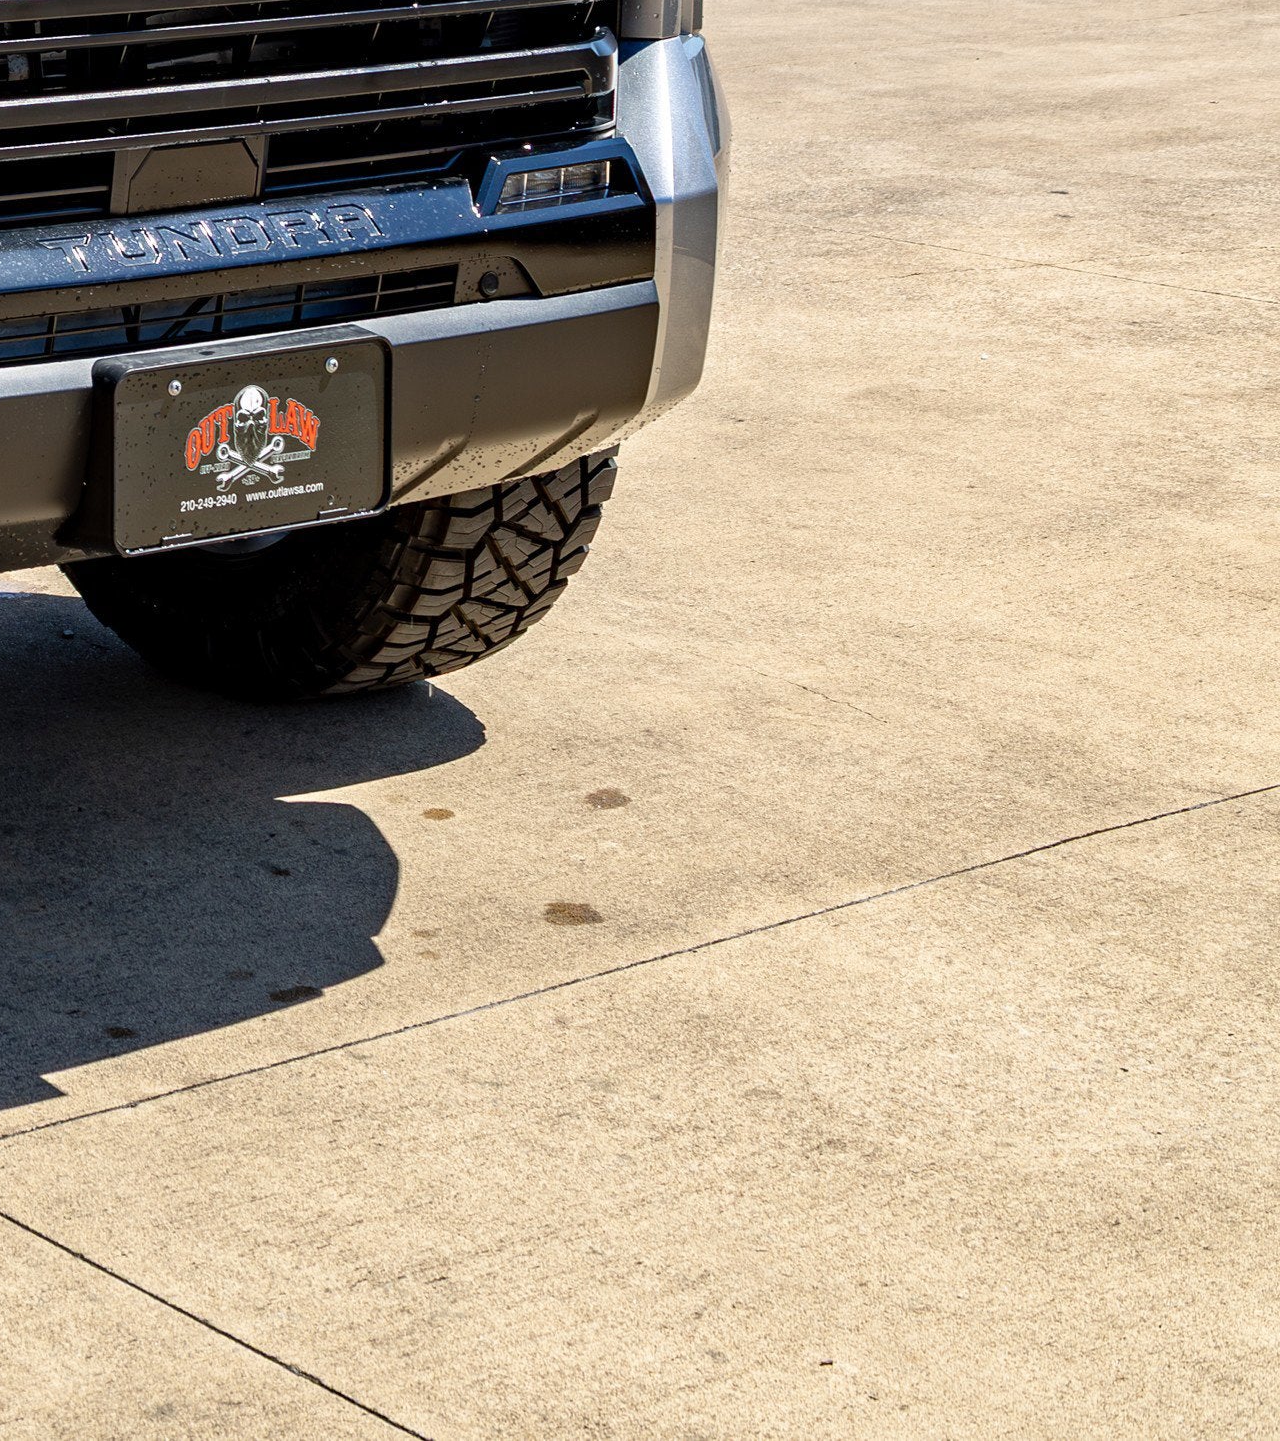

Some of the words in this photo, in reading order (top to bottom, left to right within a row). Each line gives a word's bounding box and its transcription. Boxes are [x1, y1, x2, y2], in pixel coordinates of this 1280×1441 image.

[40, 203, 386, 273] TUNDRA
[180, 493, 238, 513] 210-249-2940
[246, 481, 324, 503] www.outlawsa.com
